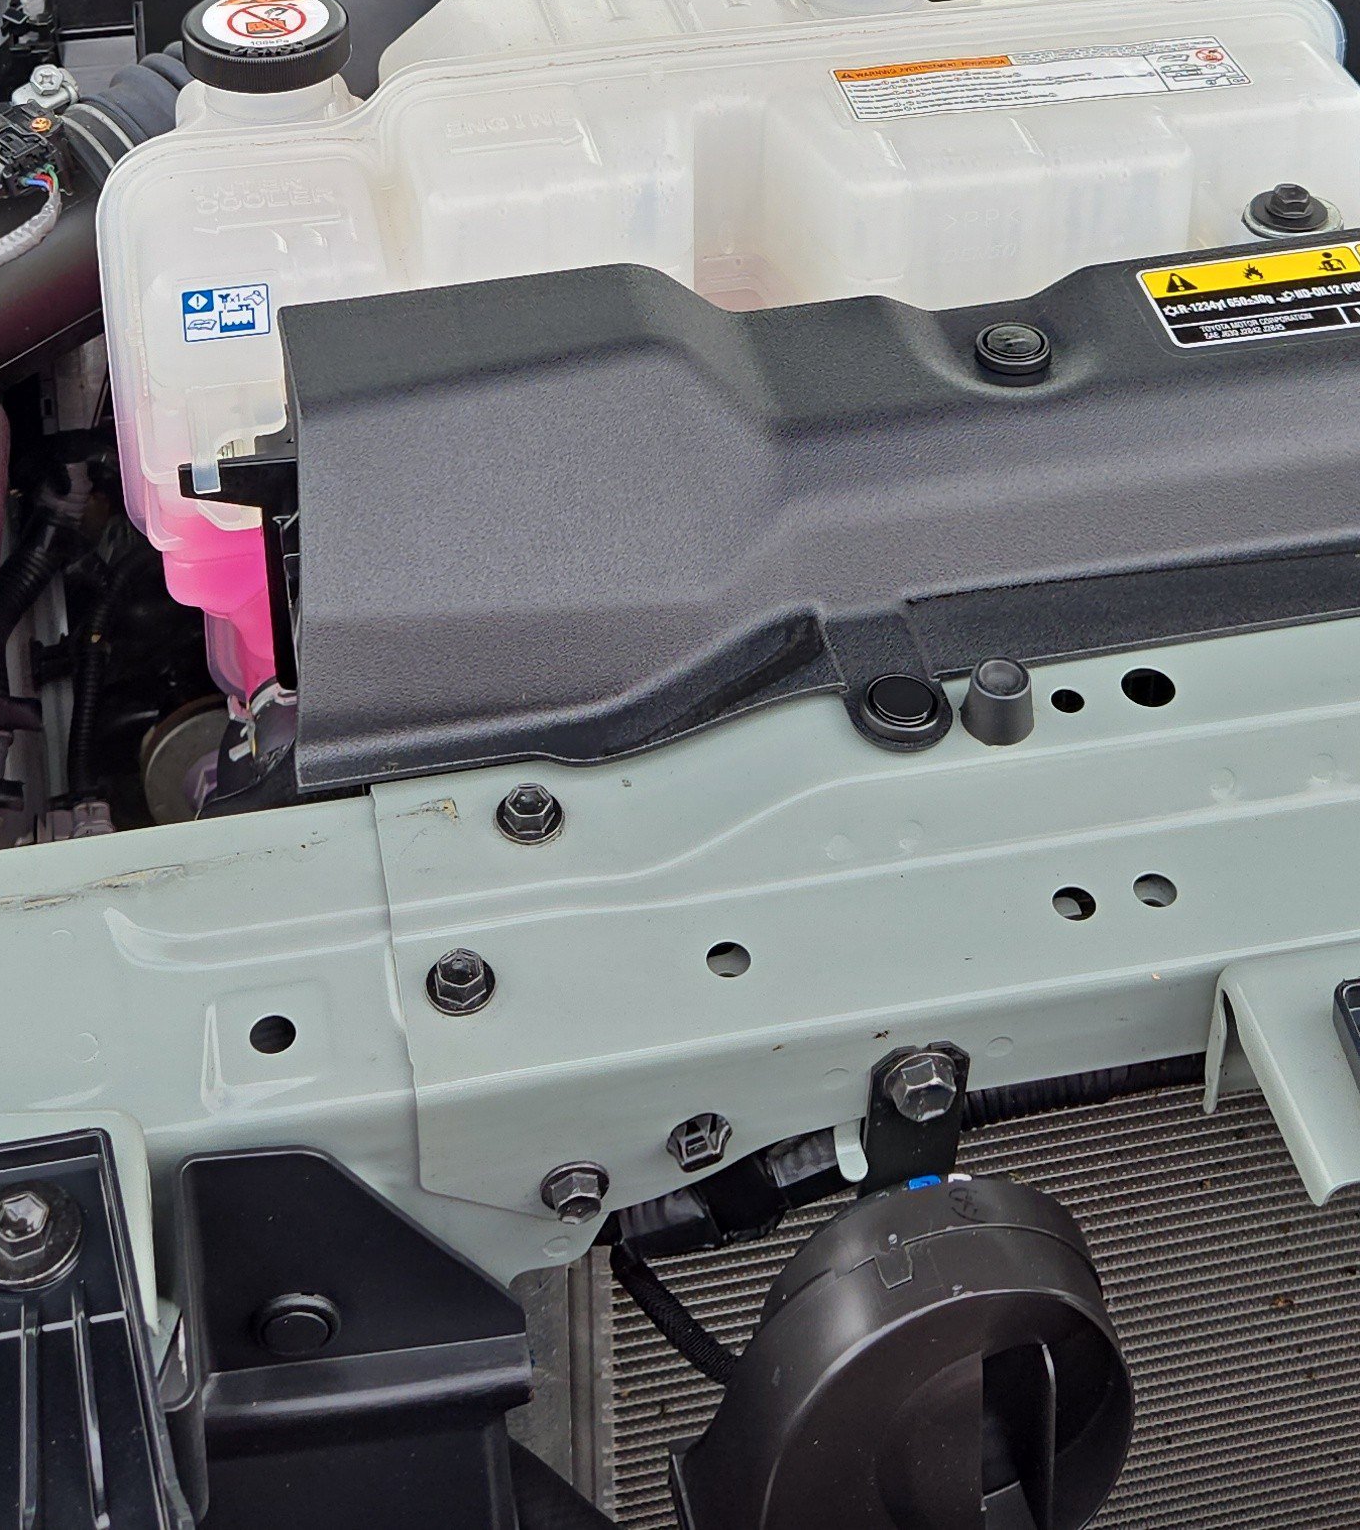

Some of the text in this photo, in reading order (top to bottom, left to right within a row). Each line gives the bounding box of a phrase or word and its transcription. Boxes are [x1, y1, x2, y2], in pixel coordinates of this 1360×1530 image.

[855, 68, 897, 78] WARNING
[1199, 312, 1314, 332] TOYOTA MOTOR CORPORATION
